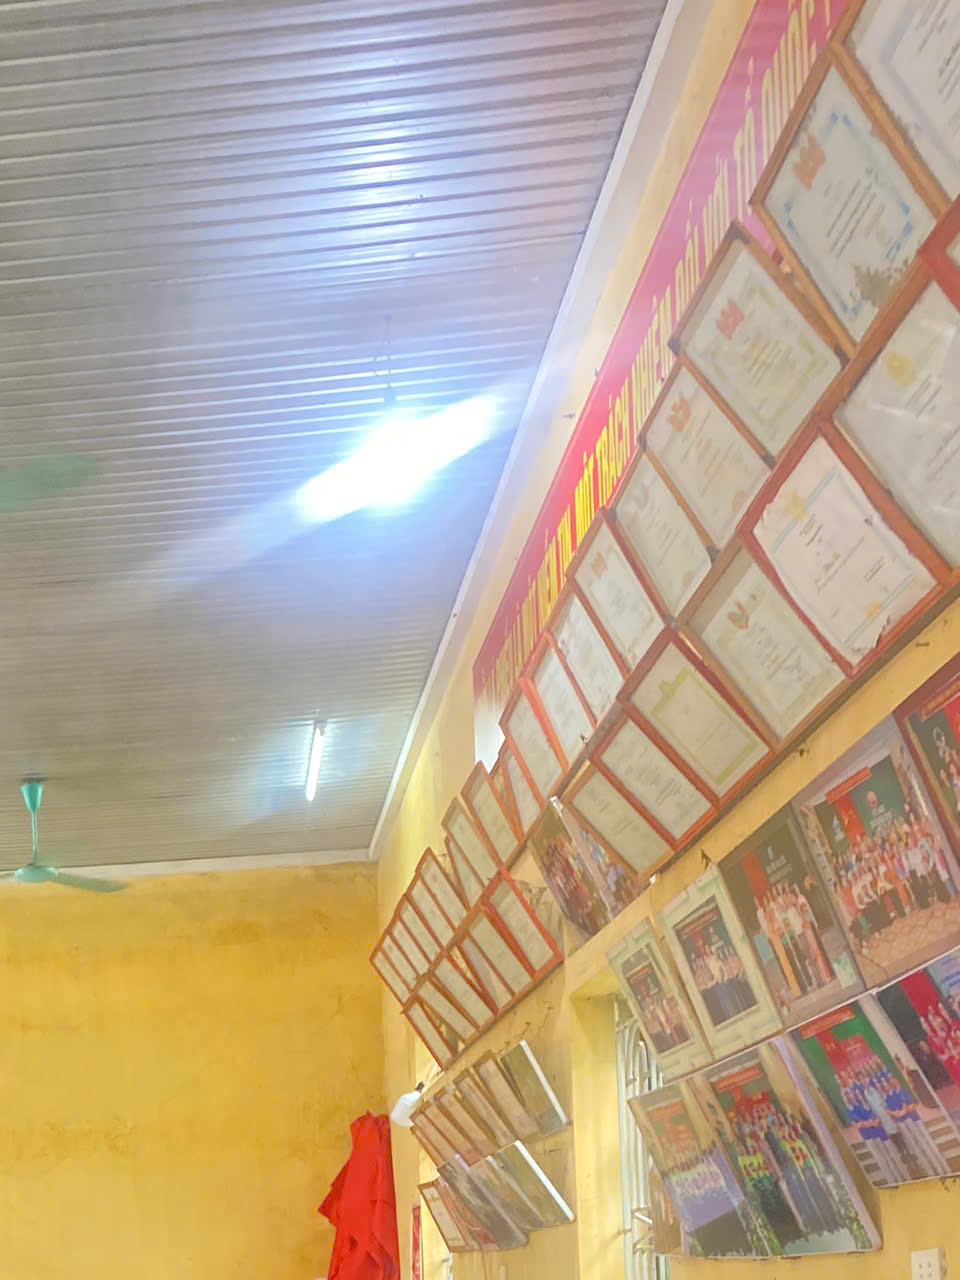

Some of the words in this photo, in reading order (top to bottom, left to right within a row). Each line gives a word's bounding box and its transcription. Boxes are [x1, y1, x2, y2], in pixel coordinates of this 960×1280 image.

[574, 450, 595, 547] MỘT
[595, 377, 631, 507] TRÁCH
[631, 283, 674, 446] NHIỆM
[702, 151, 730, 269] VỚI
[733, 55, 758, 223] TỔ
